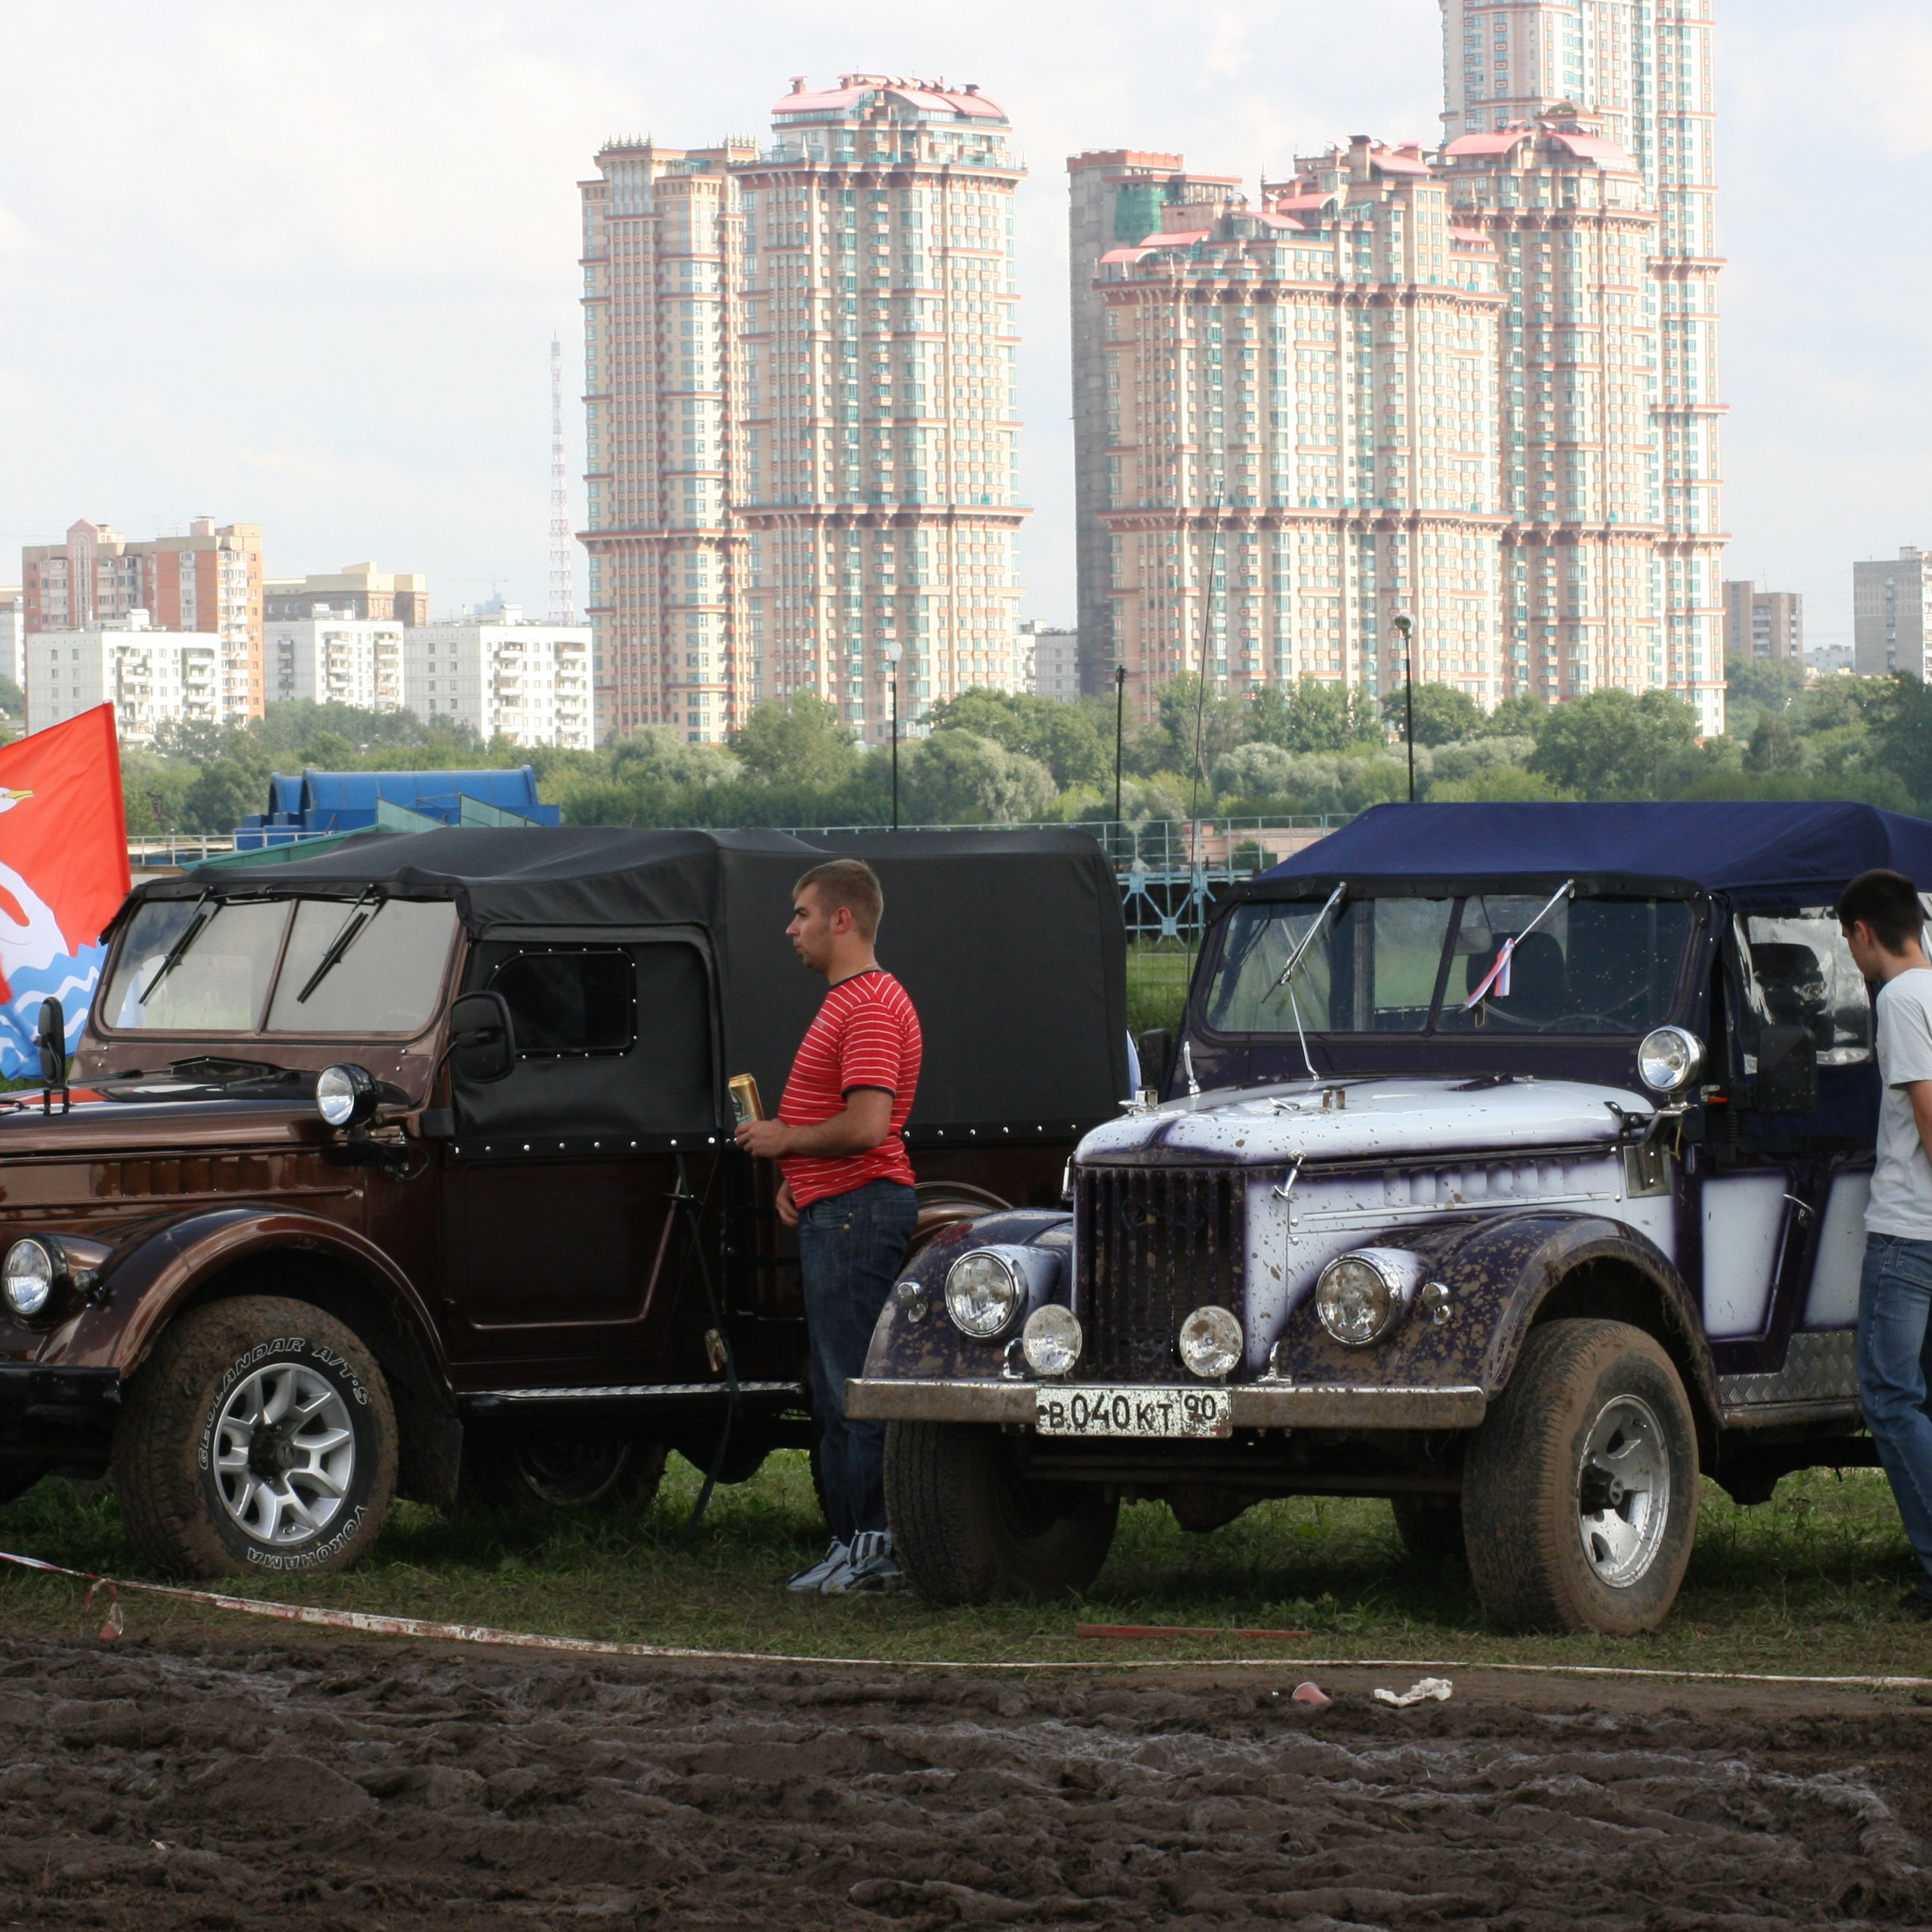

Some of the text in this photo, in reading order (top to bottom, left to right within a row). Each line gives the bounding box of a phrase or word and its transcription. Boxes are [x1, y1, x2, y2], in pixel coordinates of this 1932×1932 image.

[198, 1337, 305, 1469] GEOLANDAR
[1184, 1395, 1217, 1421] 90
[247, 1505, 368, 1570] YOKOHAMA
